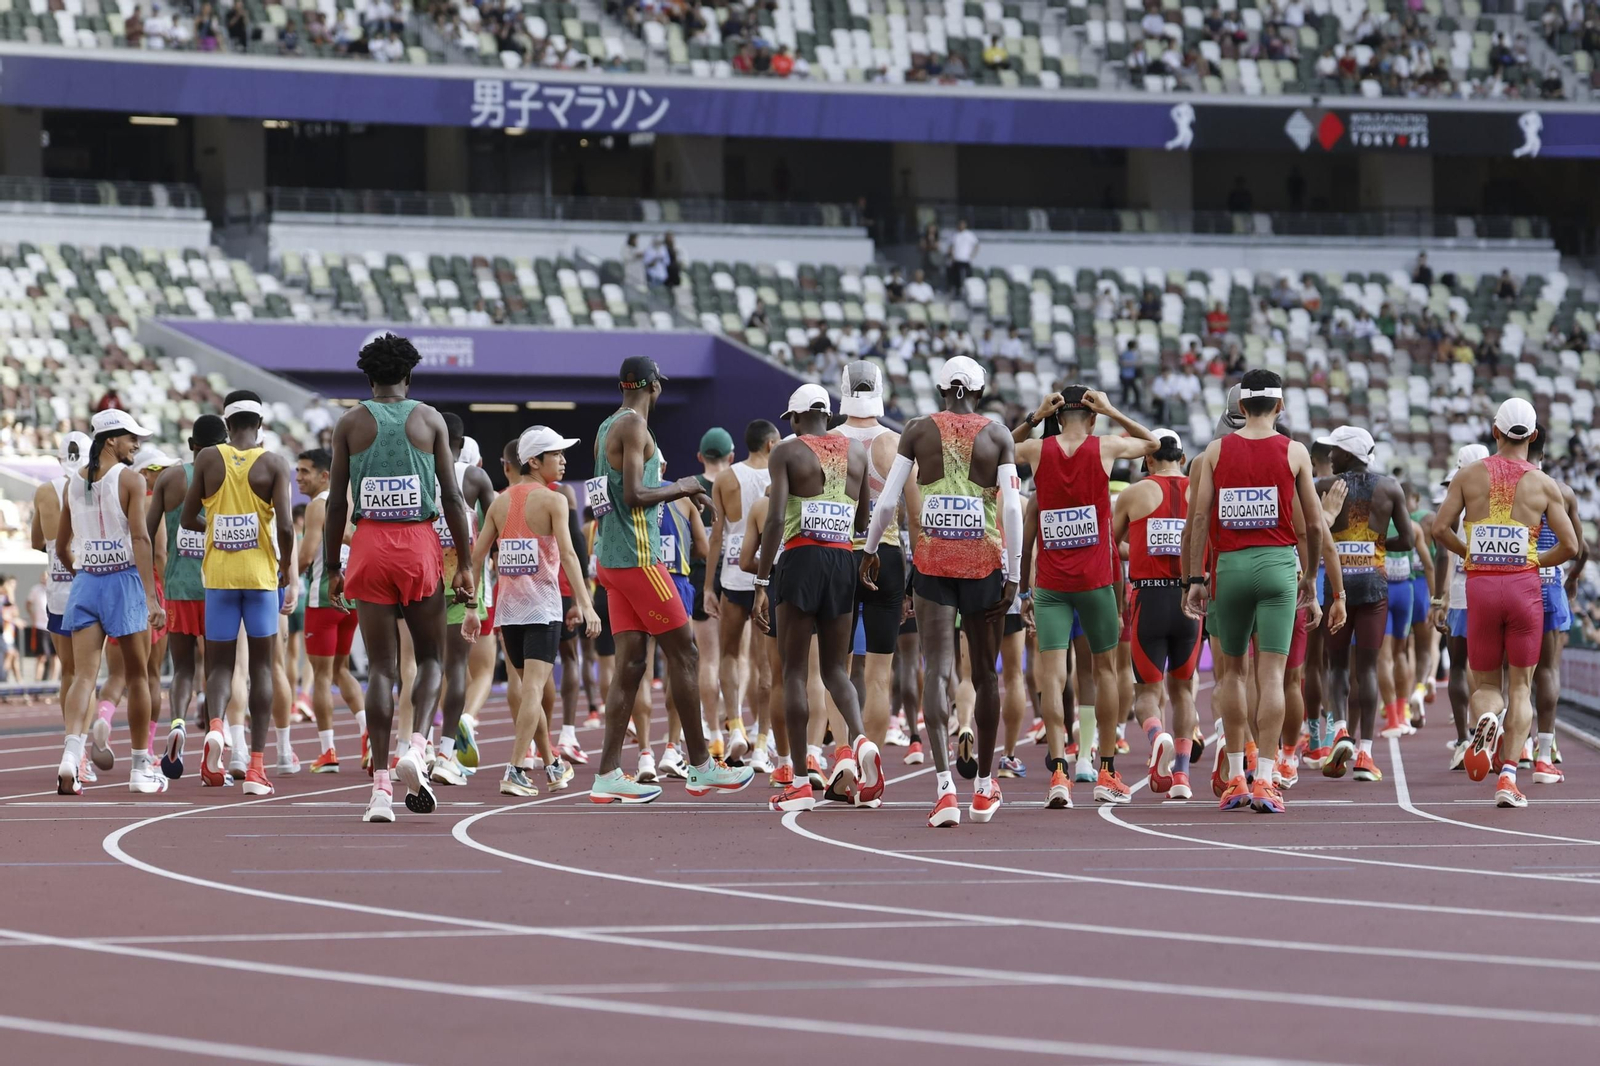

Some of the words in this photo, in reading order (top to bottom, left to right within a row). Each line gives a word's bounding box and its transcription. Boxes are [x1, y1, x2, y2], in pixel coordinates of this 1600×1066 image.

[470, 79, 670, 130] 男子マラソン
[376, 478, 416, 491] TDK
[364, 492, 418, 508] TAKELE
[1234, 489, 1273, 502] TDK
[818, 502, 852, 518] TDK
[939, 497, 980, 511] TDK
[1221, 504, 1276, 518] BOUQANTAR
[223, 515, 255, 527] TDK
[925, 513, 982, 527] NGETICH
[1053, 508, 1092, 523] TDK
[804, 516, 851, 533] KIPKOECH
[1043, 527, 1055, 539] EL
[1056, 522, 1096, 538] GOUMRI
[215, 529, 221, 541] S.
[222, 527, 257, 541] HASSAN
[1486, 526, 1524, 540] TDK
[91, 538, 124, 551] TDK
[504, 540, 534, 551] TDK
[1340, 543, 1371, 554] TDK
[1477, 540, 1521, 554] YANG
[84, 551, 127, 565] AOUANI
[1341, 556, 1374, 566] LANGAT
[1140, 579, 1169, 588] PERU
